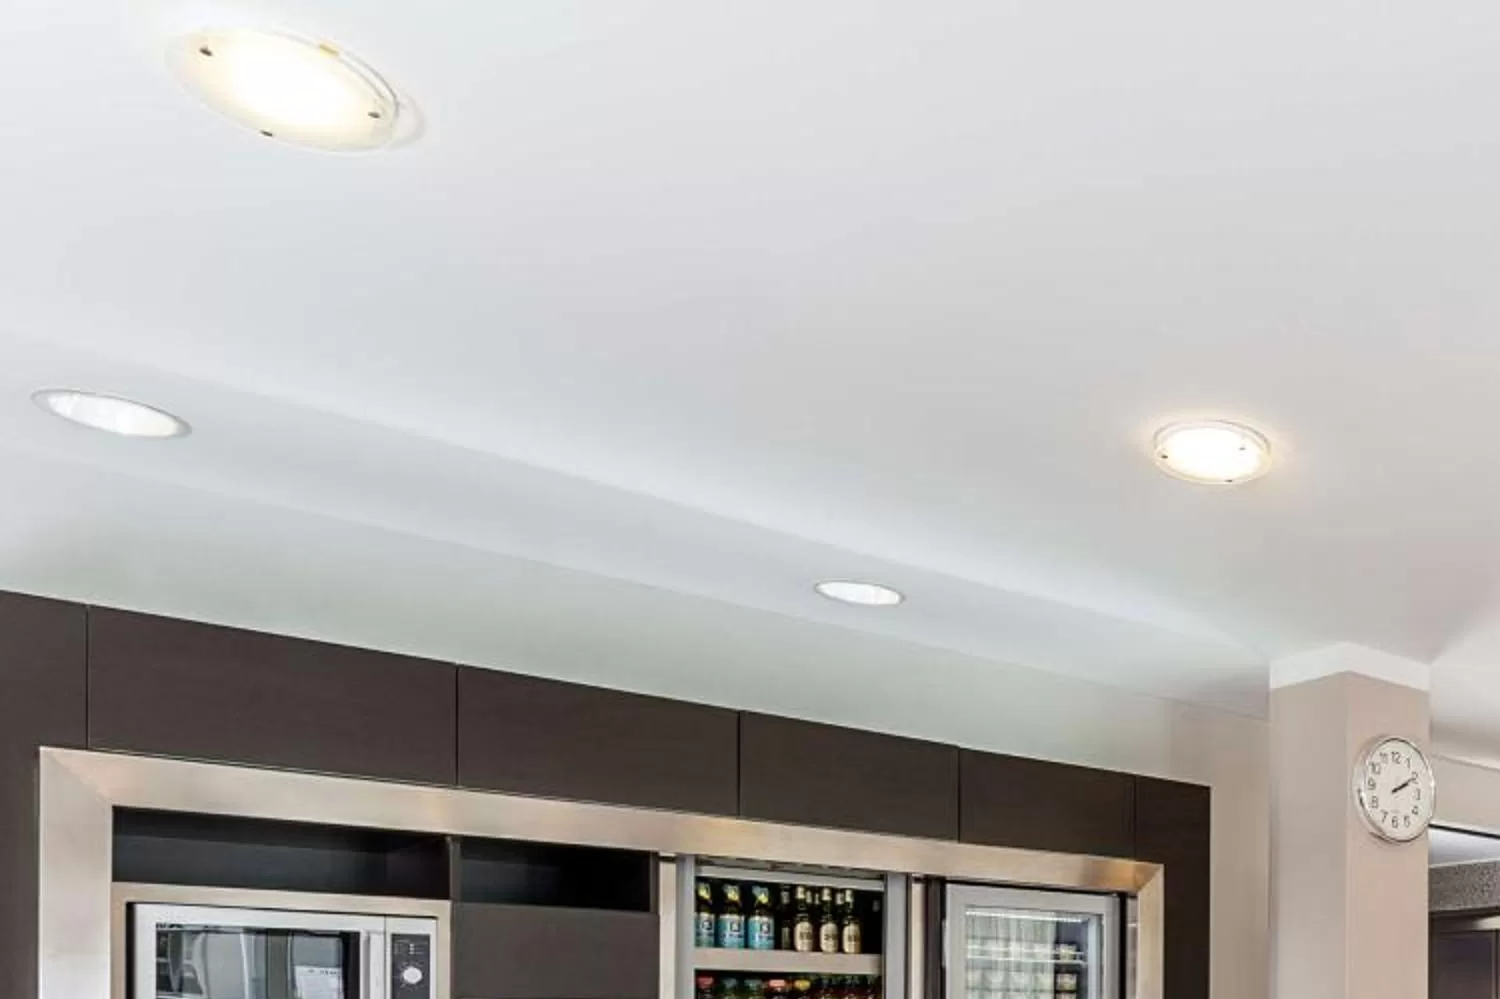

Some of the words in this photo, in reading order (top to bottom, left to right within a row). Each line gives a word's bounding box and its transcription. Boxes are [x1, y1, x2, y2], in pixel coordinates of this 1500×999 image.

[1391, 751, 1401, 765] 12
[1369, 761, 1381, 775] 10
[1367, 777, 1377, 791] 9
[1411, 771, 1419, 785] 2
[1371, 795, 1379, 809] 8
[1380, 809, 1389, 823] 7
[1391, 815, 1399, 829] 6
